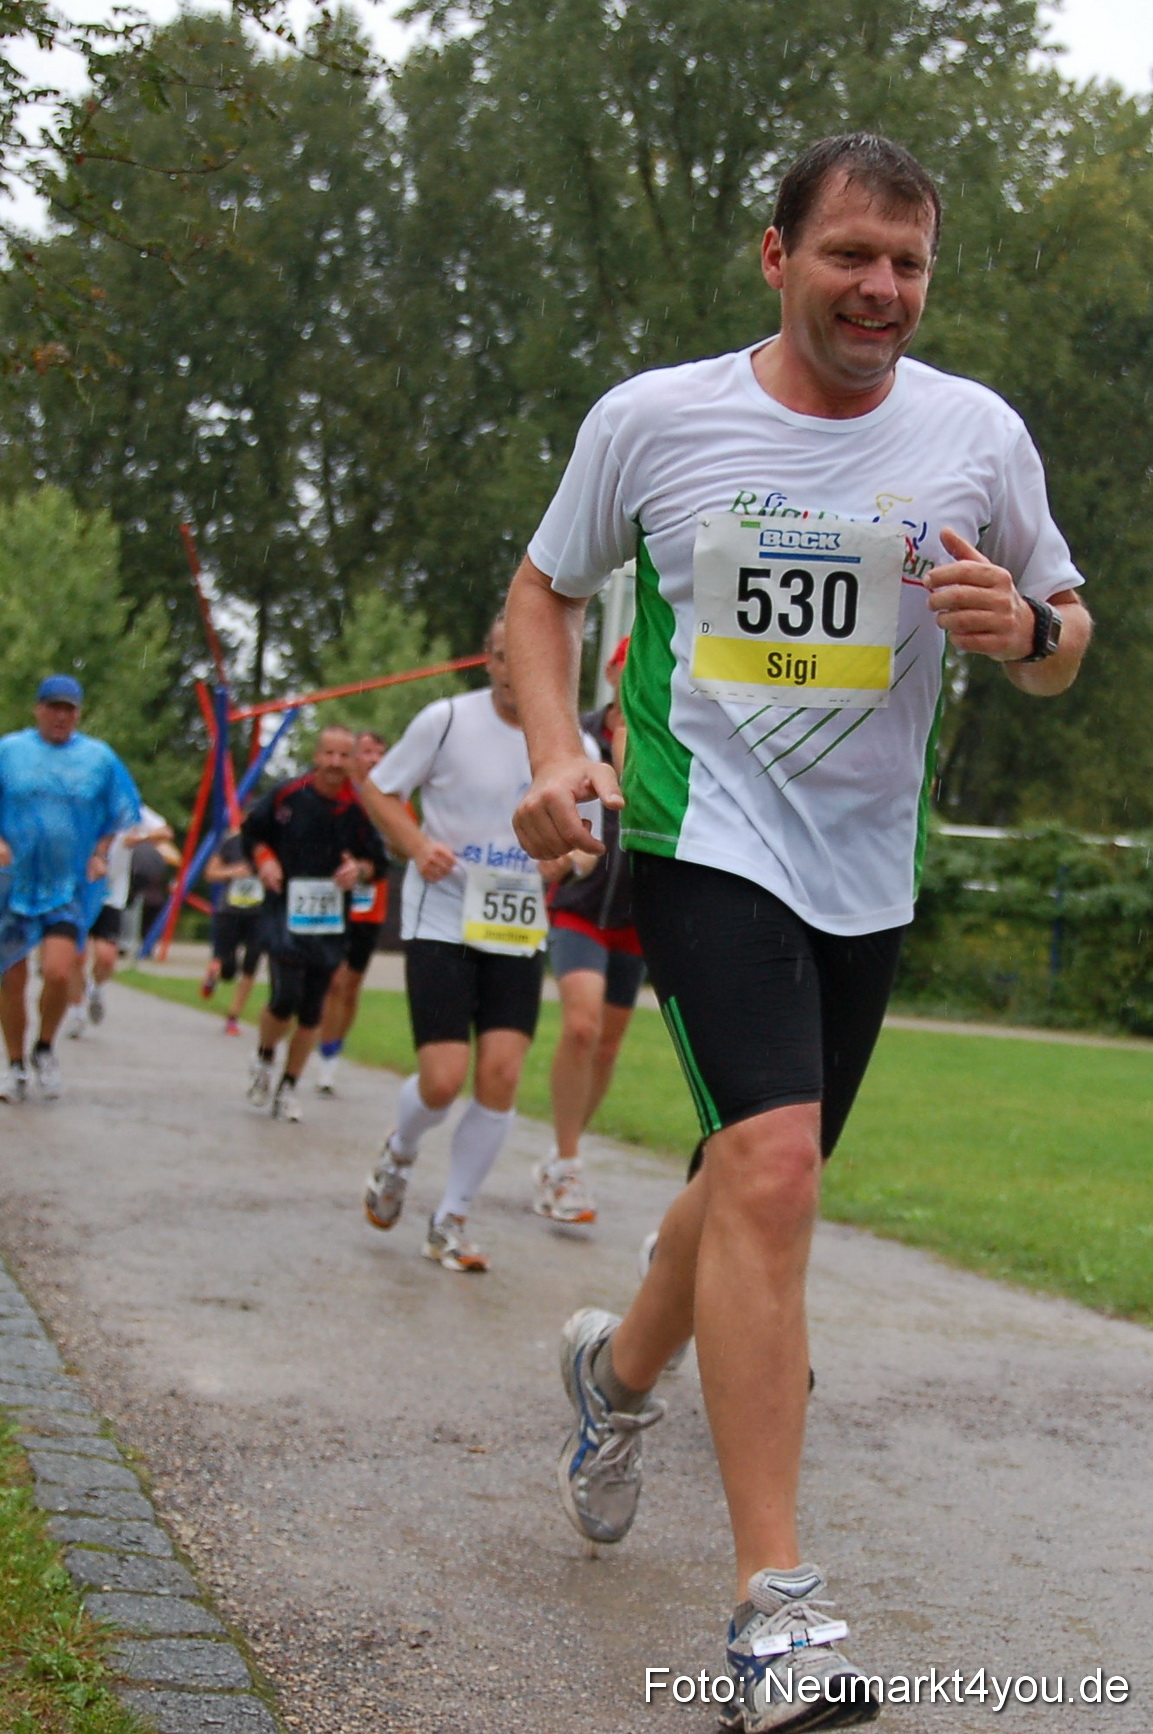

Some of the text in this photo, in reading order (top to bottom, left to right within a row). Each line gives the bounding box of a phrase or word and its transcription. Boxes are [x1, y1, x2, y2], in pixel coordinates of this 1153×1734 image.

[759, 529, 841, 550] BOCK
[737, 567, 858, 638] 530
[702, 622, 710, 634] D
[766, 651, 817, 685] Sigi
[483, 891, 537, 925] 556
